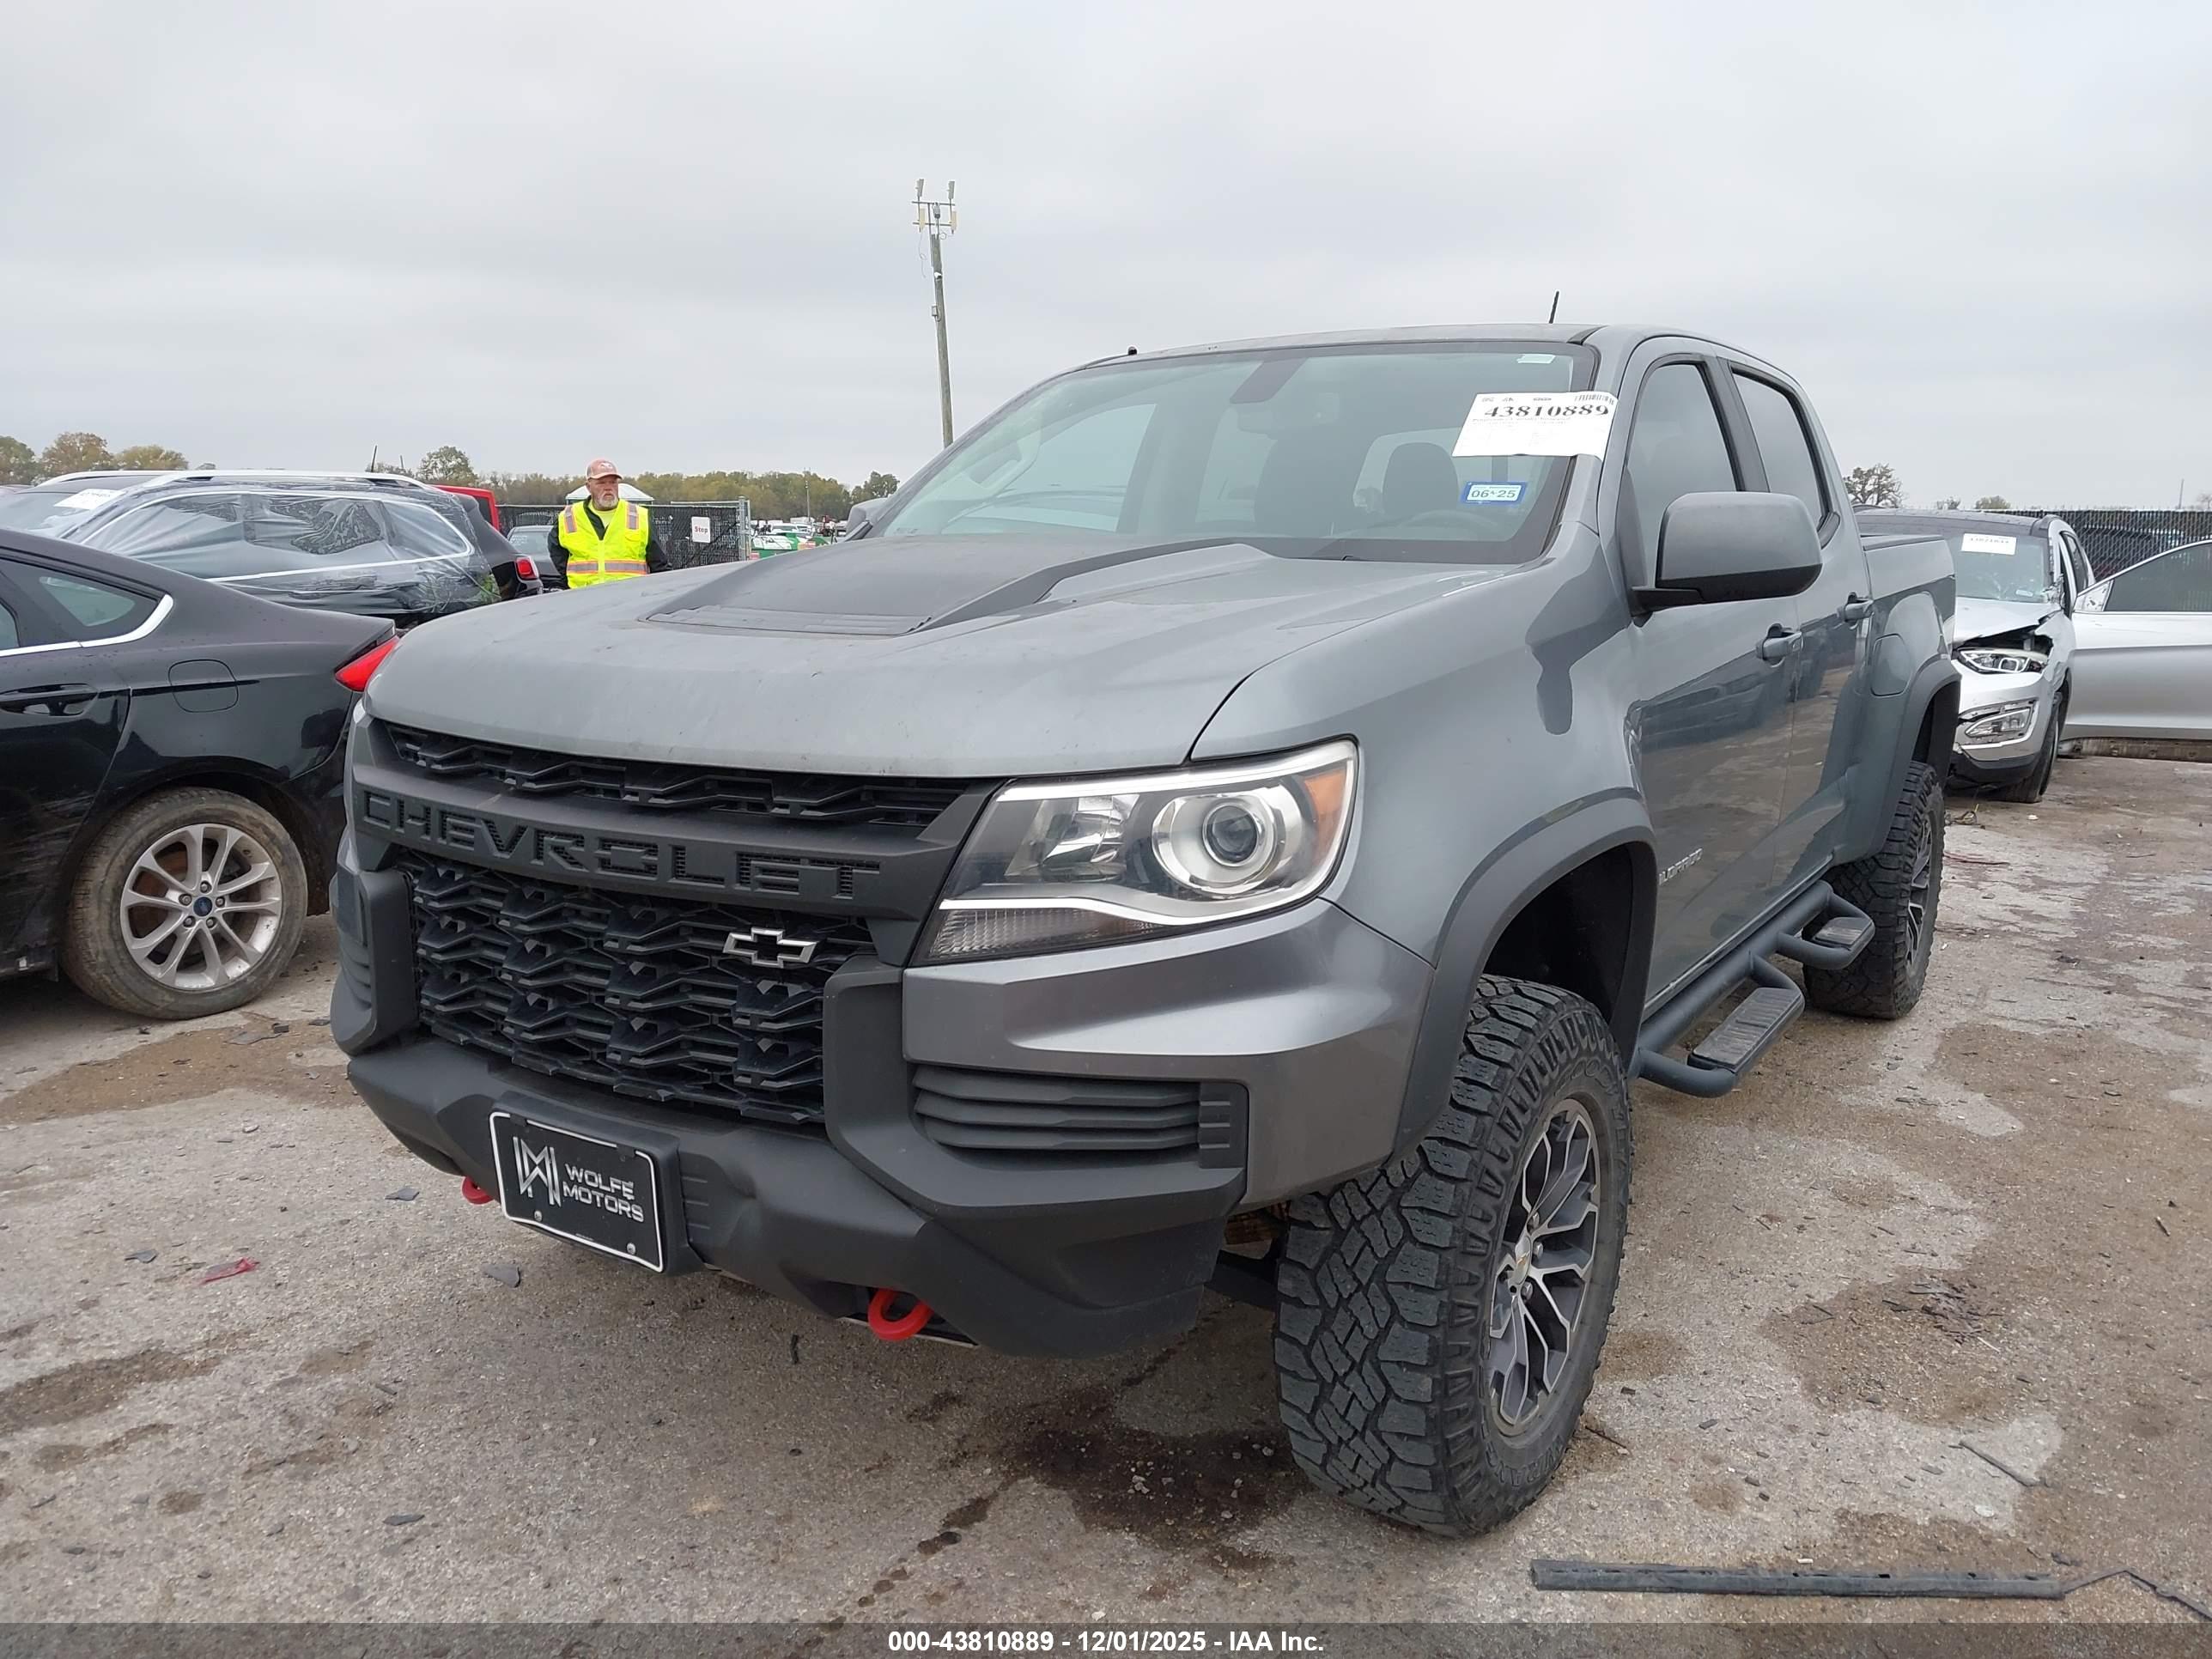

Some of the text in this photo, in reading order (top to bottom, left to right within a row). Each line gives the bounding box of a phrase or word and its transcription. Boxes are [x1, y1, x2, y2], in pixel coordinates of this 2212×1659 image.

[1484, 404, 1609, 417] 43810889
[363, 789, 881, 900] CHEVROLET
[564, 1163, 635, 1200] WOLFE
[562, 1181, 644, 1223] MOTORS
